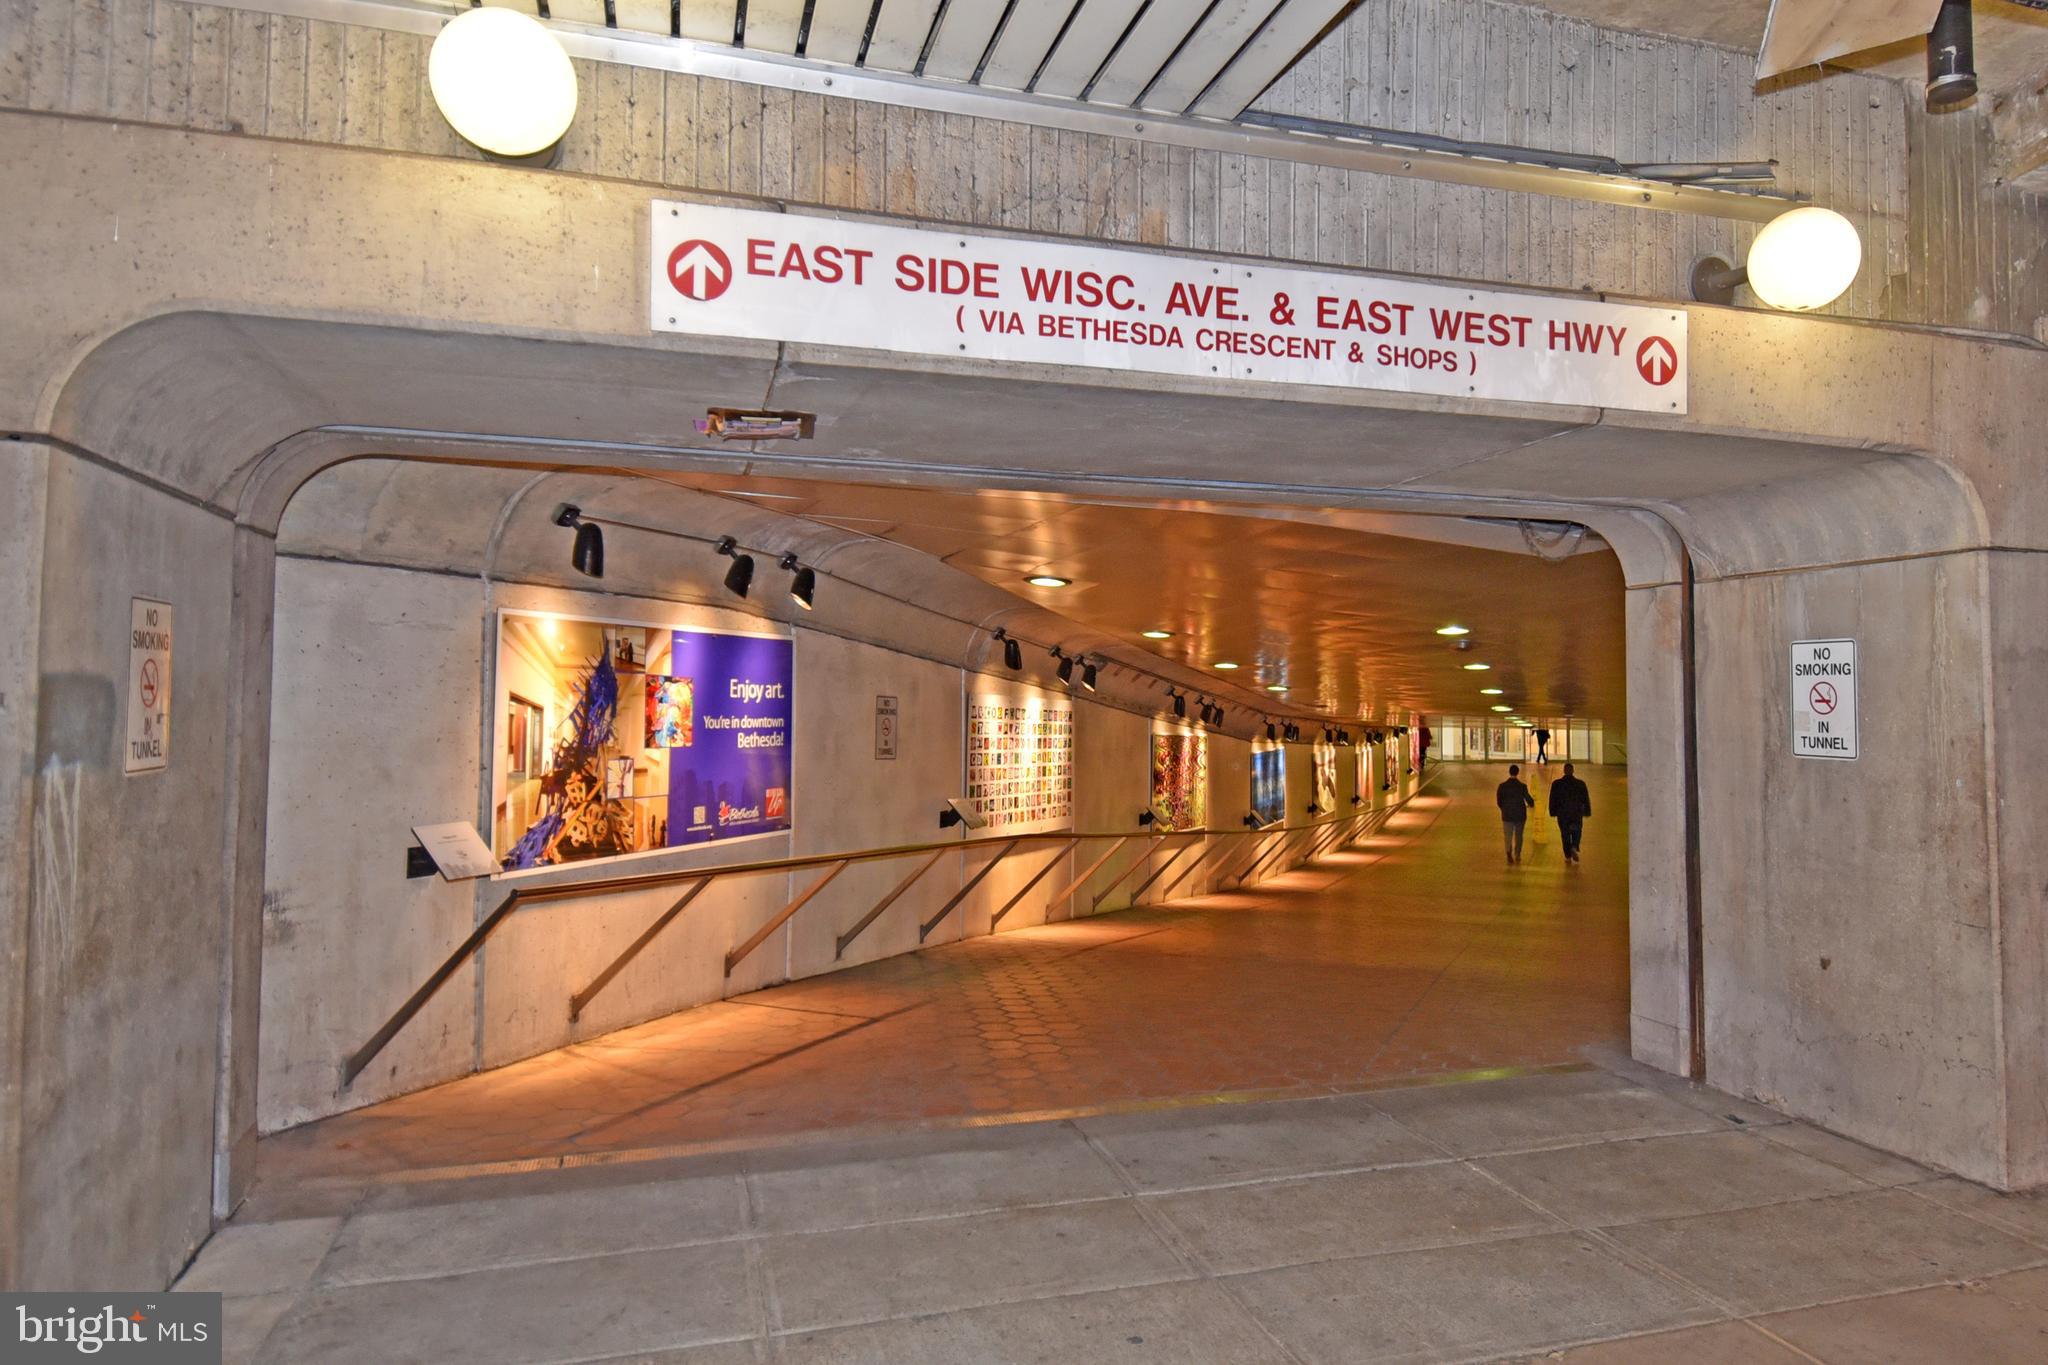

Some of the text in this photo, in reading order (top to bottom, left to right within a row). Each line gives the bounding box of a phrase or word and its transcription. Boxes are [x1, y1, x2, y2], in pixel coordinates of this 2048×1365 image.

[746, 238, 1629, 358] EAST SIDE WISC. AVE. & EAST WEST HWY
[980, 309, 1025, 335] VIA
[1038, 313, 1184, 349] BETHESDA
[1195, 327, 1336, 361] CRESCENT
[1347, 342, 1364, 364] &
[1377, 344, 1458, 372] SHOPS
[146, 608, 158, 627] NO
[132, 630, 169, 651] SMOKING
[1813, 647, 1831, 661] NO
[1795, 663, 1852, 677] SMOKING
[730, 678, 785, 703] Enjoy art.
[703, 715, 784, 729] You're in downtown
[1817, 721, 1830, 733] IN
[737, 731, 784, 748] Bethesda!
[1801, 736, 1849, 751] TUNNEL
[131, 739, 162, 760] TUNNEL
